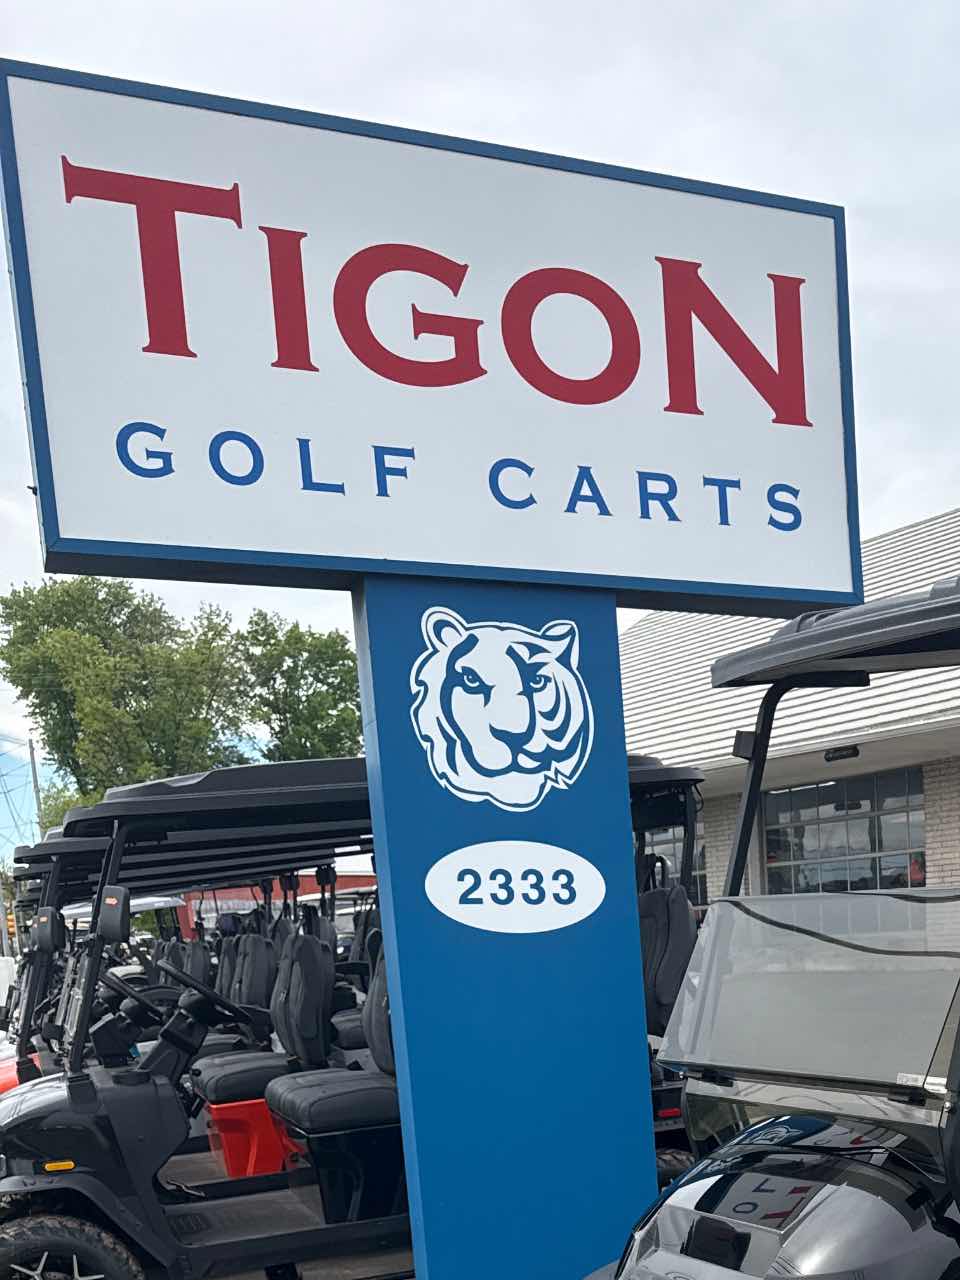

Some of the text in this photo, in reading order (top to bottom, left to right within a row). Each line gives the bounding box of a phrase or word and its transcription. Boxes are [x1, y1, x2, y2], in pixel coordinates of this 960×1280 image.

[62, 155, 814, 428] TIGON
[115, 421, 803, 534] GOLF CARTS
[457, 867, 578, 907] 2333
